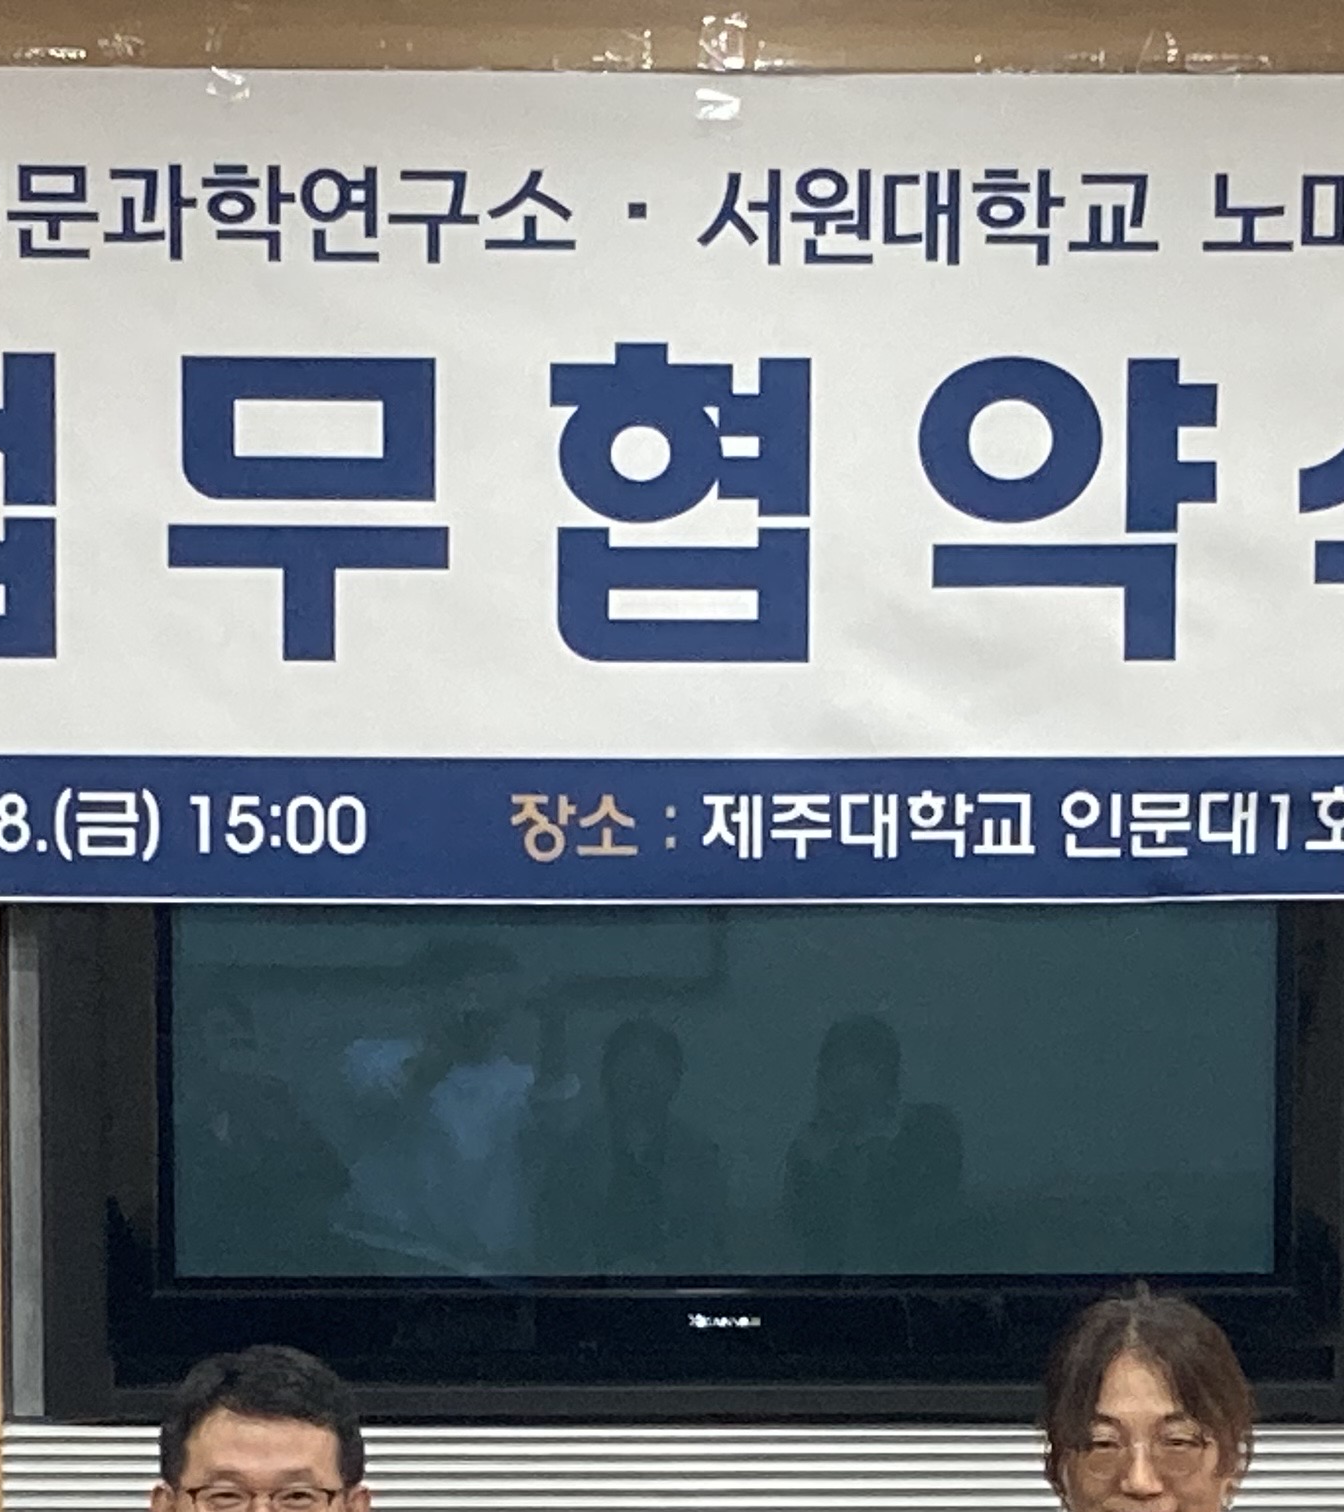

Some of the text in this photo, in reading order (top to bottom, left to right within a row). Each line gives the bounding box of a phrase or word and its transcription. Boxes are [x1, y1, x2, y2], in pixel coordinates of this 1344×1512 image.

[697, 168, 1159, 266] 서원대학교
[190, 794, 367, 855] 15:00
[511, 794, 637, 862] 장소
[703, 789, 1036, 860] 제주대학교
